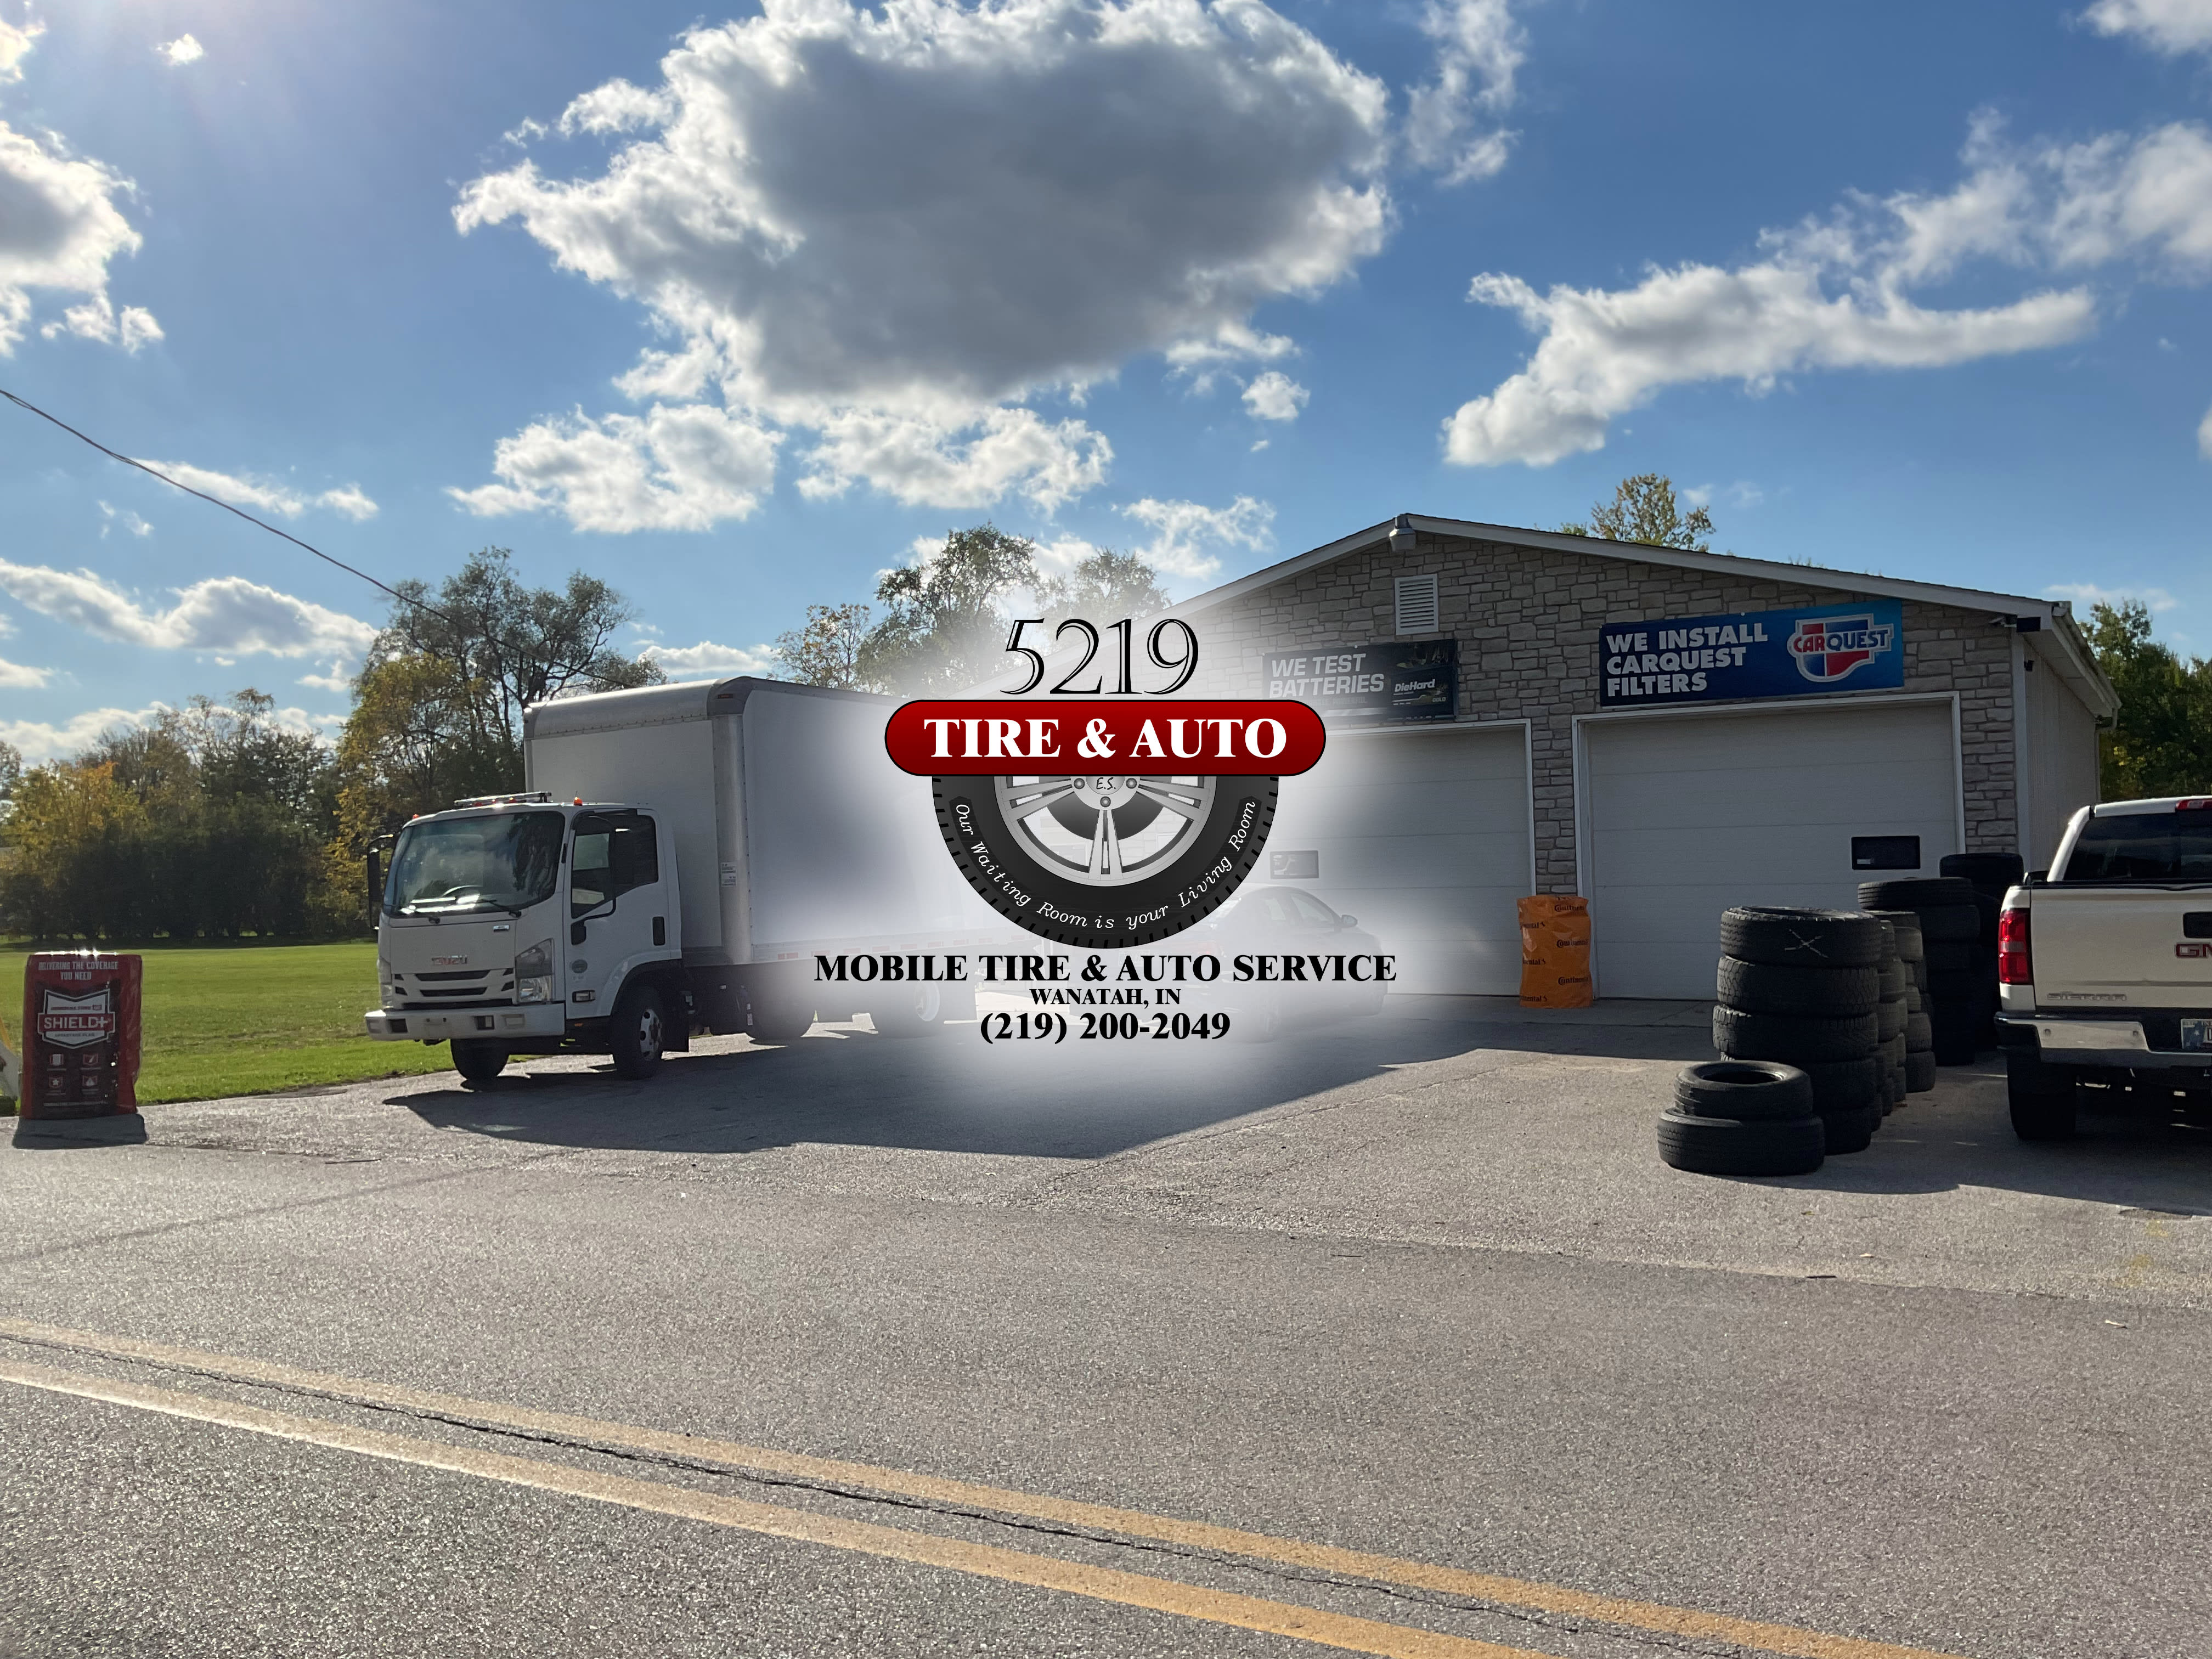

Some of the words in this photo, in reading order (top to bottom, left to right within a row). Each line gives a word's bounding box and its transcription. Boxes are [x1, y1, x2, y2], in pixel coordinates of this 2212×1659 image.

[1606, 629, 1647, 653] WE
[1658, 623, 1768, 649] INSTALL
[1792, 629, 1889, 653] CARQUEST
[1272, 658, 1307, 677] WE
[1312, 653, 1367, 675] TEST
[1606, 646, 1746, 675] CARQUEST
[1269, 673, 1385, 698] BATTERIES
[1394, 679, 1436, 693] DieHard
[1607, 672, 1707, 697] FILTERS
[61, 972, 72, 980] YOU
[75, 972, 92, 980] NEED
[72, 961, 84, 969] THE
[87, 961, 119, 969] COVERAGE
[2047, 991, 2126, 1001] SIERRA
